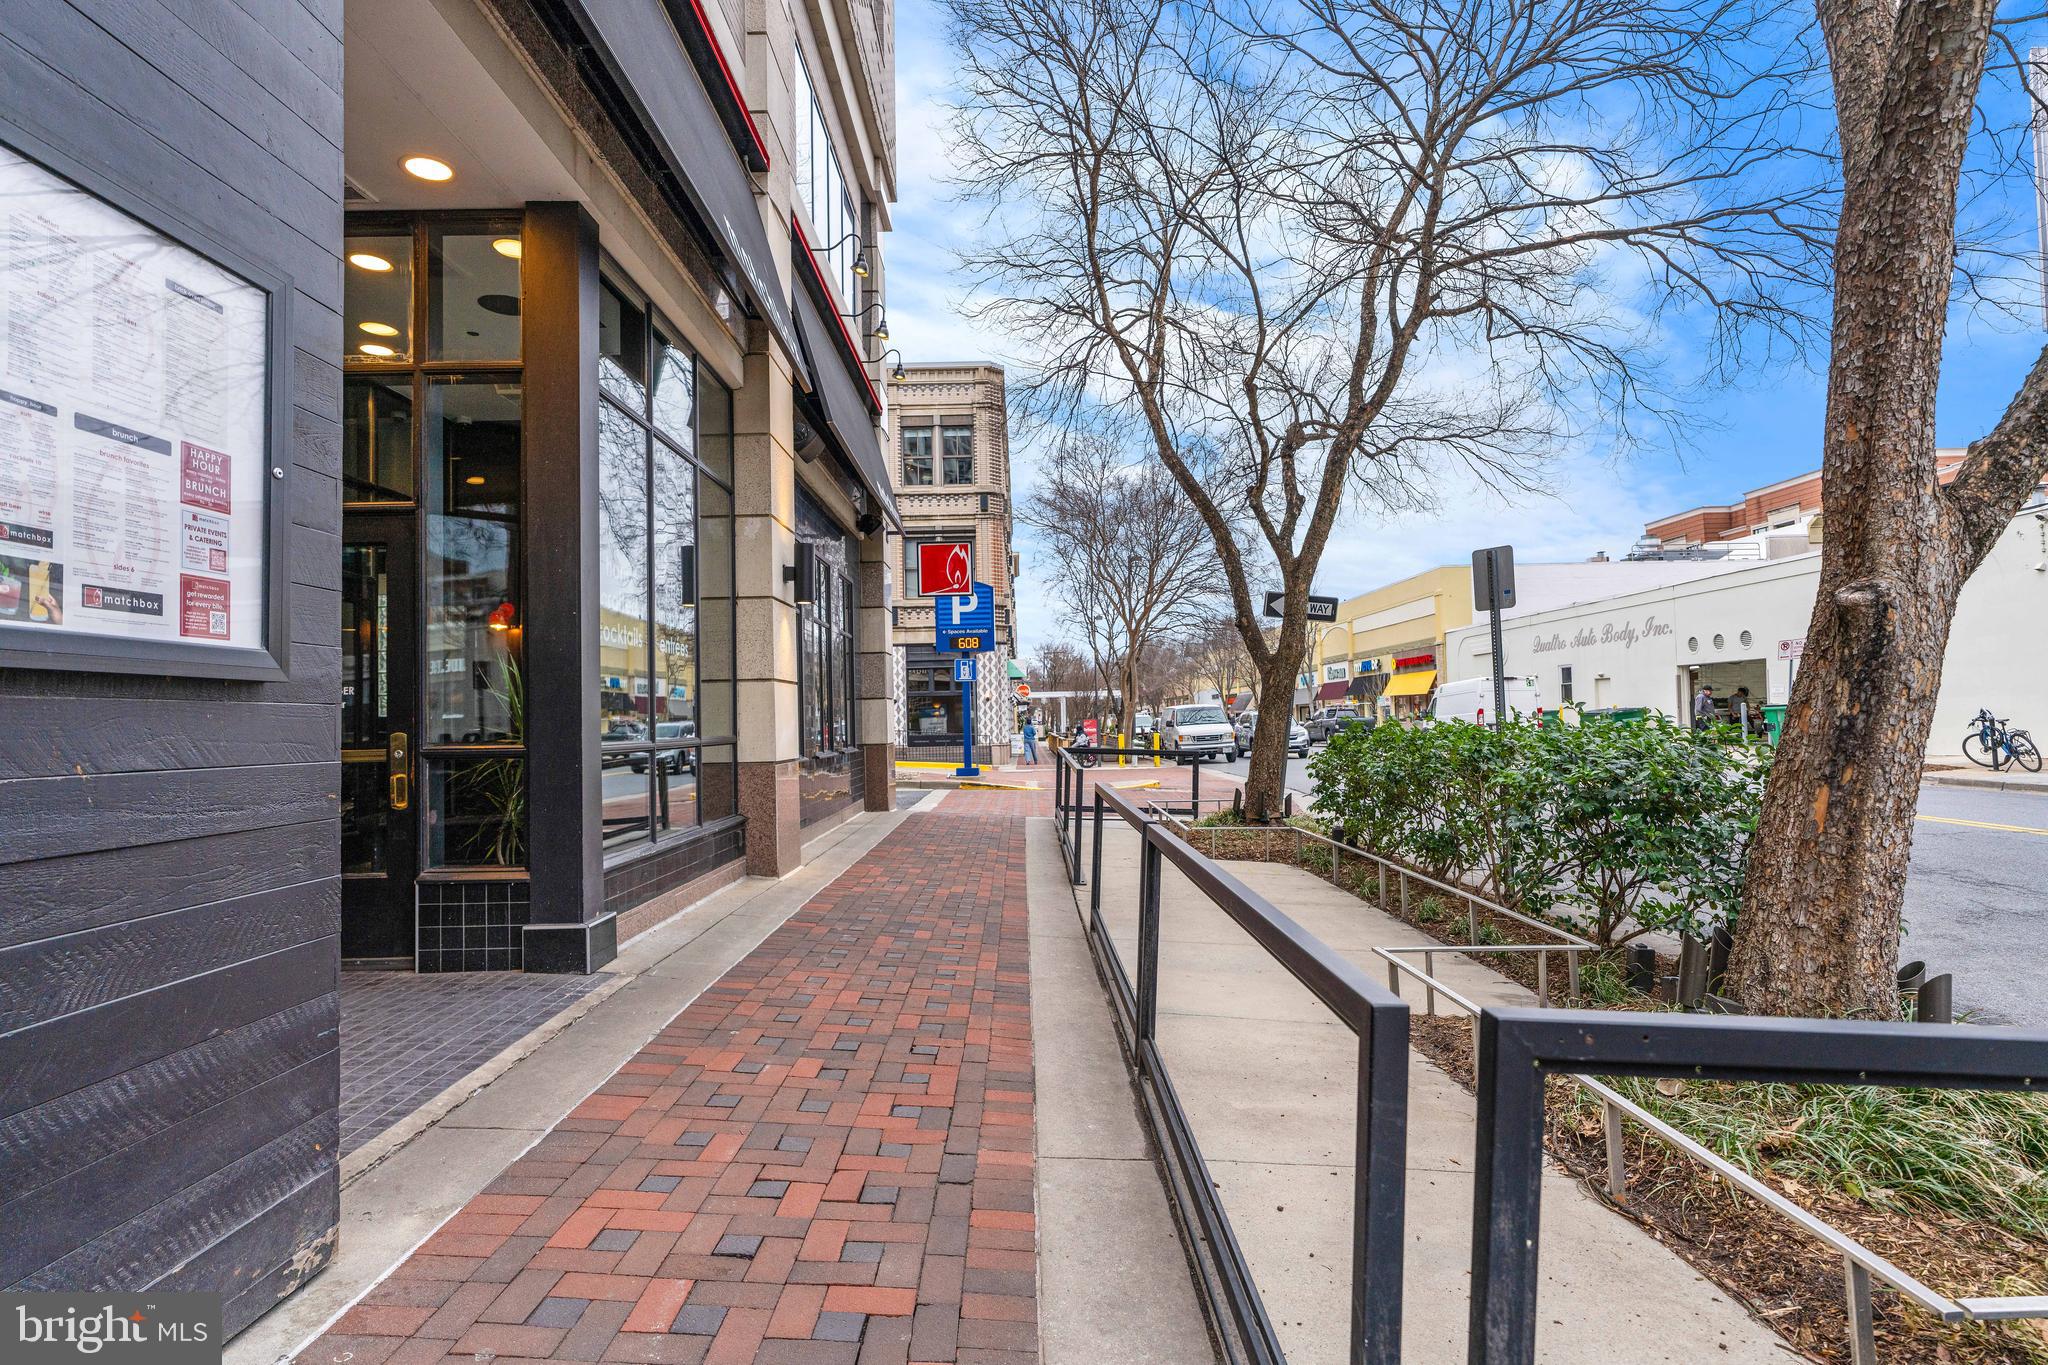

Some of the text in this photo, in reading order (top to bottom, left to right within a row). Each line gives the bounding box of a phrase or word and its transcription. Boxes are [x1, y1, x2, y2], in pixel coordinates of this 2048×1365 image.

[112, 427, 139, 443] brunch
[99, 449, 122, 461] brunch
[123, 456, 150, 469] favorites
[190, 447, 223, 465] HAPPY
[192, 459, 220, 475] HOUR
[185, 479, 226, 499] BRUNCH
[10, 530, 52, 544] matchbox
[184, 523, 227, 539] PRIVATE EVENTS
[194, 535, 223, 547] CATERING
[113, 563, 135, 573] sides 6
[104, 594, 159, 610] matchbox
[197, 592, 224, 600] rewarded
[195, 601, 211, 609] every
[952, 592, 978, 625] P
[1309, 603, 1330, 614] WAY
[1532, 615, 1673, 654] Quattro Auto Body, Inc.
[660, 636, 689, 657] entrées
[958, 637, 979, 649] 608
